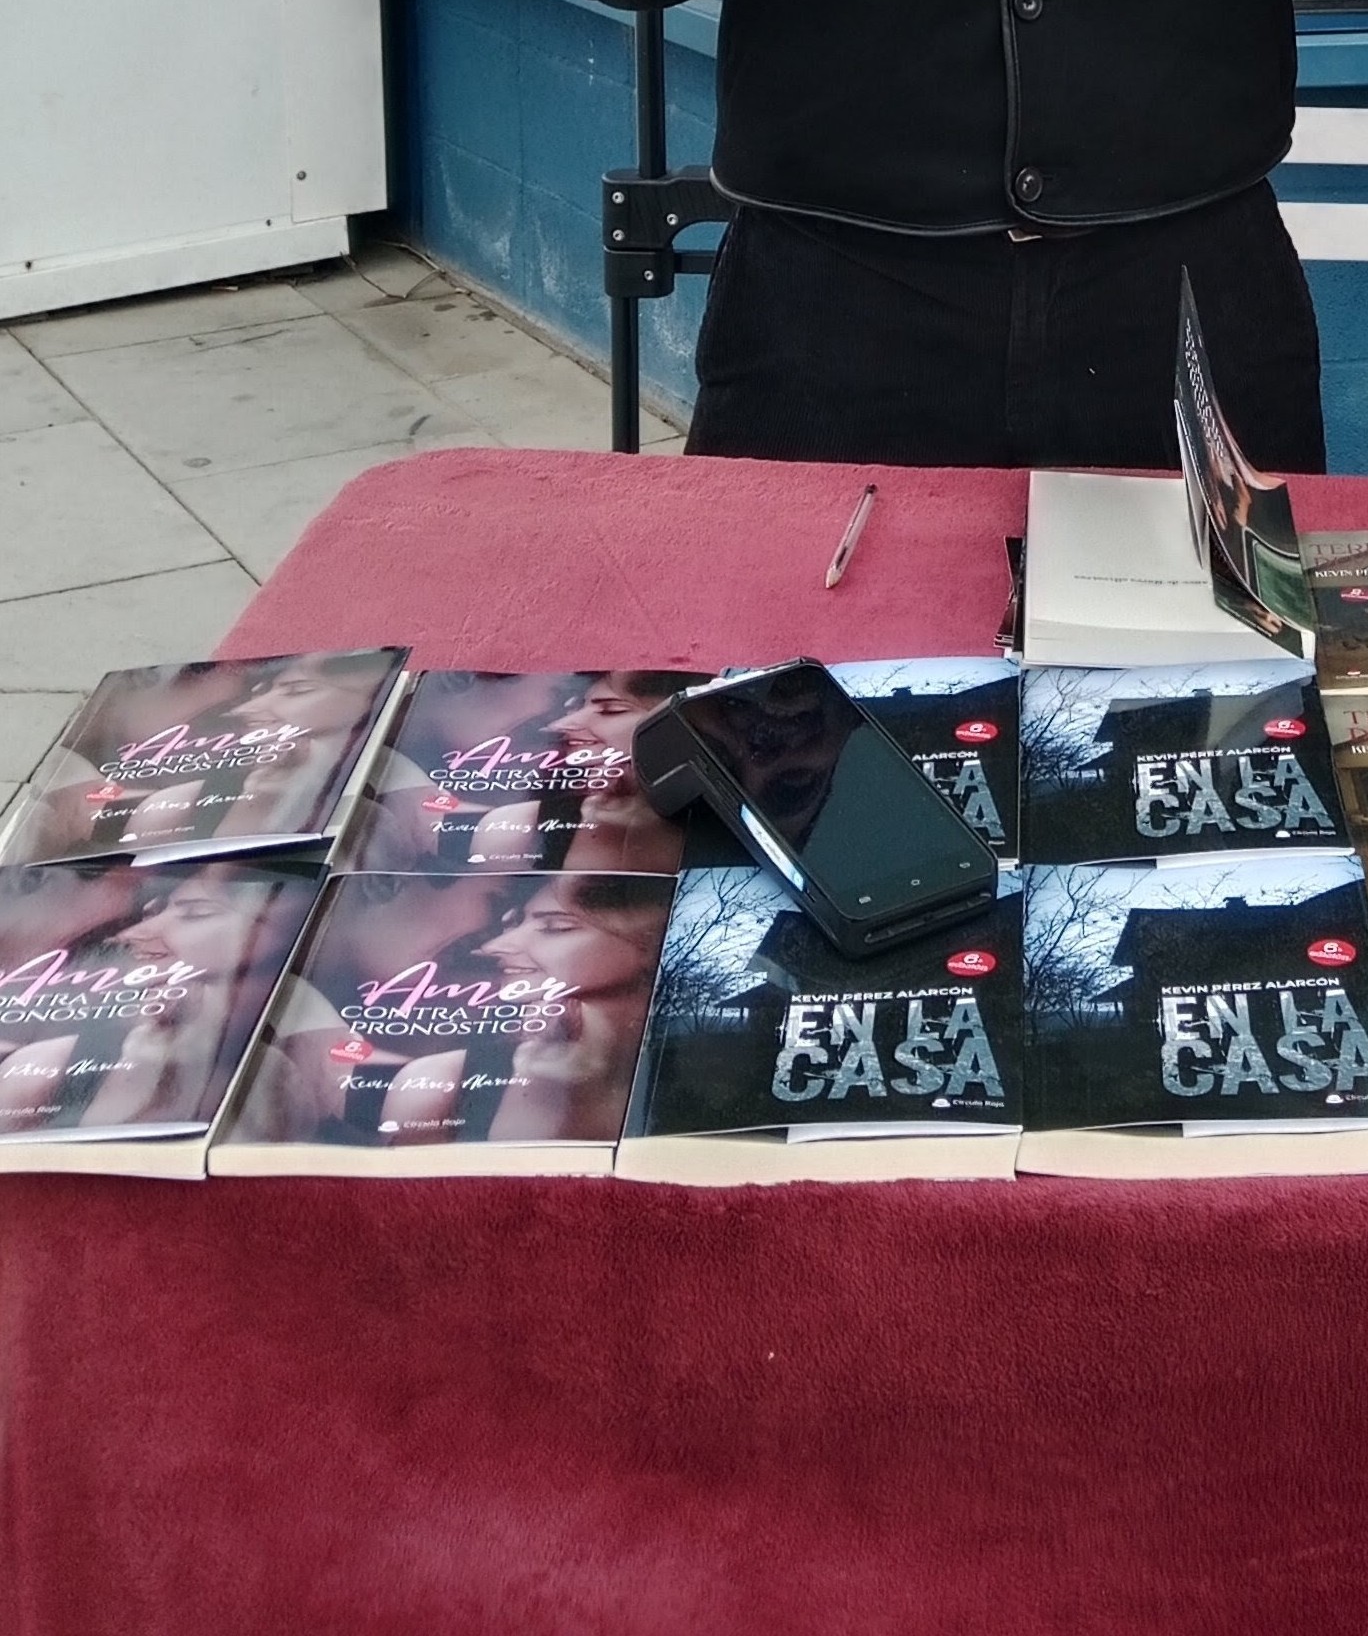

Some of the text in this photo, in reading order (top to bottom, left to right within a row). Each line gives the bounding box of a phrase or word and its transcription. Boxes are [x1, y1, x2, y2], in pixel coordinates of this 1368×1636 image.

[1315, 569, 1353, 578] KEVIN
[117, 724, 312, 762] Amor
[100, 742, 296, 774] CONTRA TODO
[442, 736, 632, 776] Amor
[911, 751, 978, 762] ALARCÓN
[1136, 746, 1291, 763] KEVIN PÉREZ ALARCÓN
[105, 753, 278, 783] PRONÓSTICO
[430, 767, 625, 780] CONTRA TODO
[1137, 754, 1306, 796] EN LA
[438, 777, 608, 792] PRONÓSTICO
[1135, 784, 1335, 837] CASA
[0, 948, 207, 1002] Amor
[1161, 977, 1340, 995] KEVIN PÉREZ ALARCÓN
[0, 987, 188, 1007] NTRA TODO
[357, 961, 581, 1015] Amor
[791, 986, 973, 1003] KEVIN PÉREZ ALARCÓN
[0, 1002, 165, 1024] ONÓSTICO
[340, 1003, 566, 1020] CONTRA TODO
[785, 997, 986, 1048] EN LA
[1162, 989, 1359, 1042] EN LA
[350, 1017, 547, 1036] PRONÓSTICO
[771, 1036, 1005, 1102] CASA
[337, 1075, 396, 1090] Kevin
